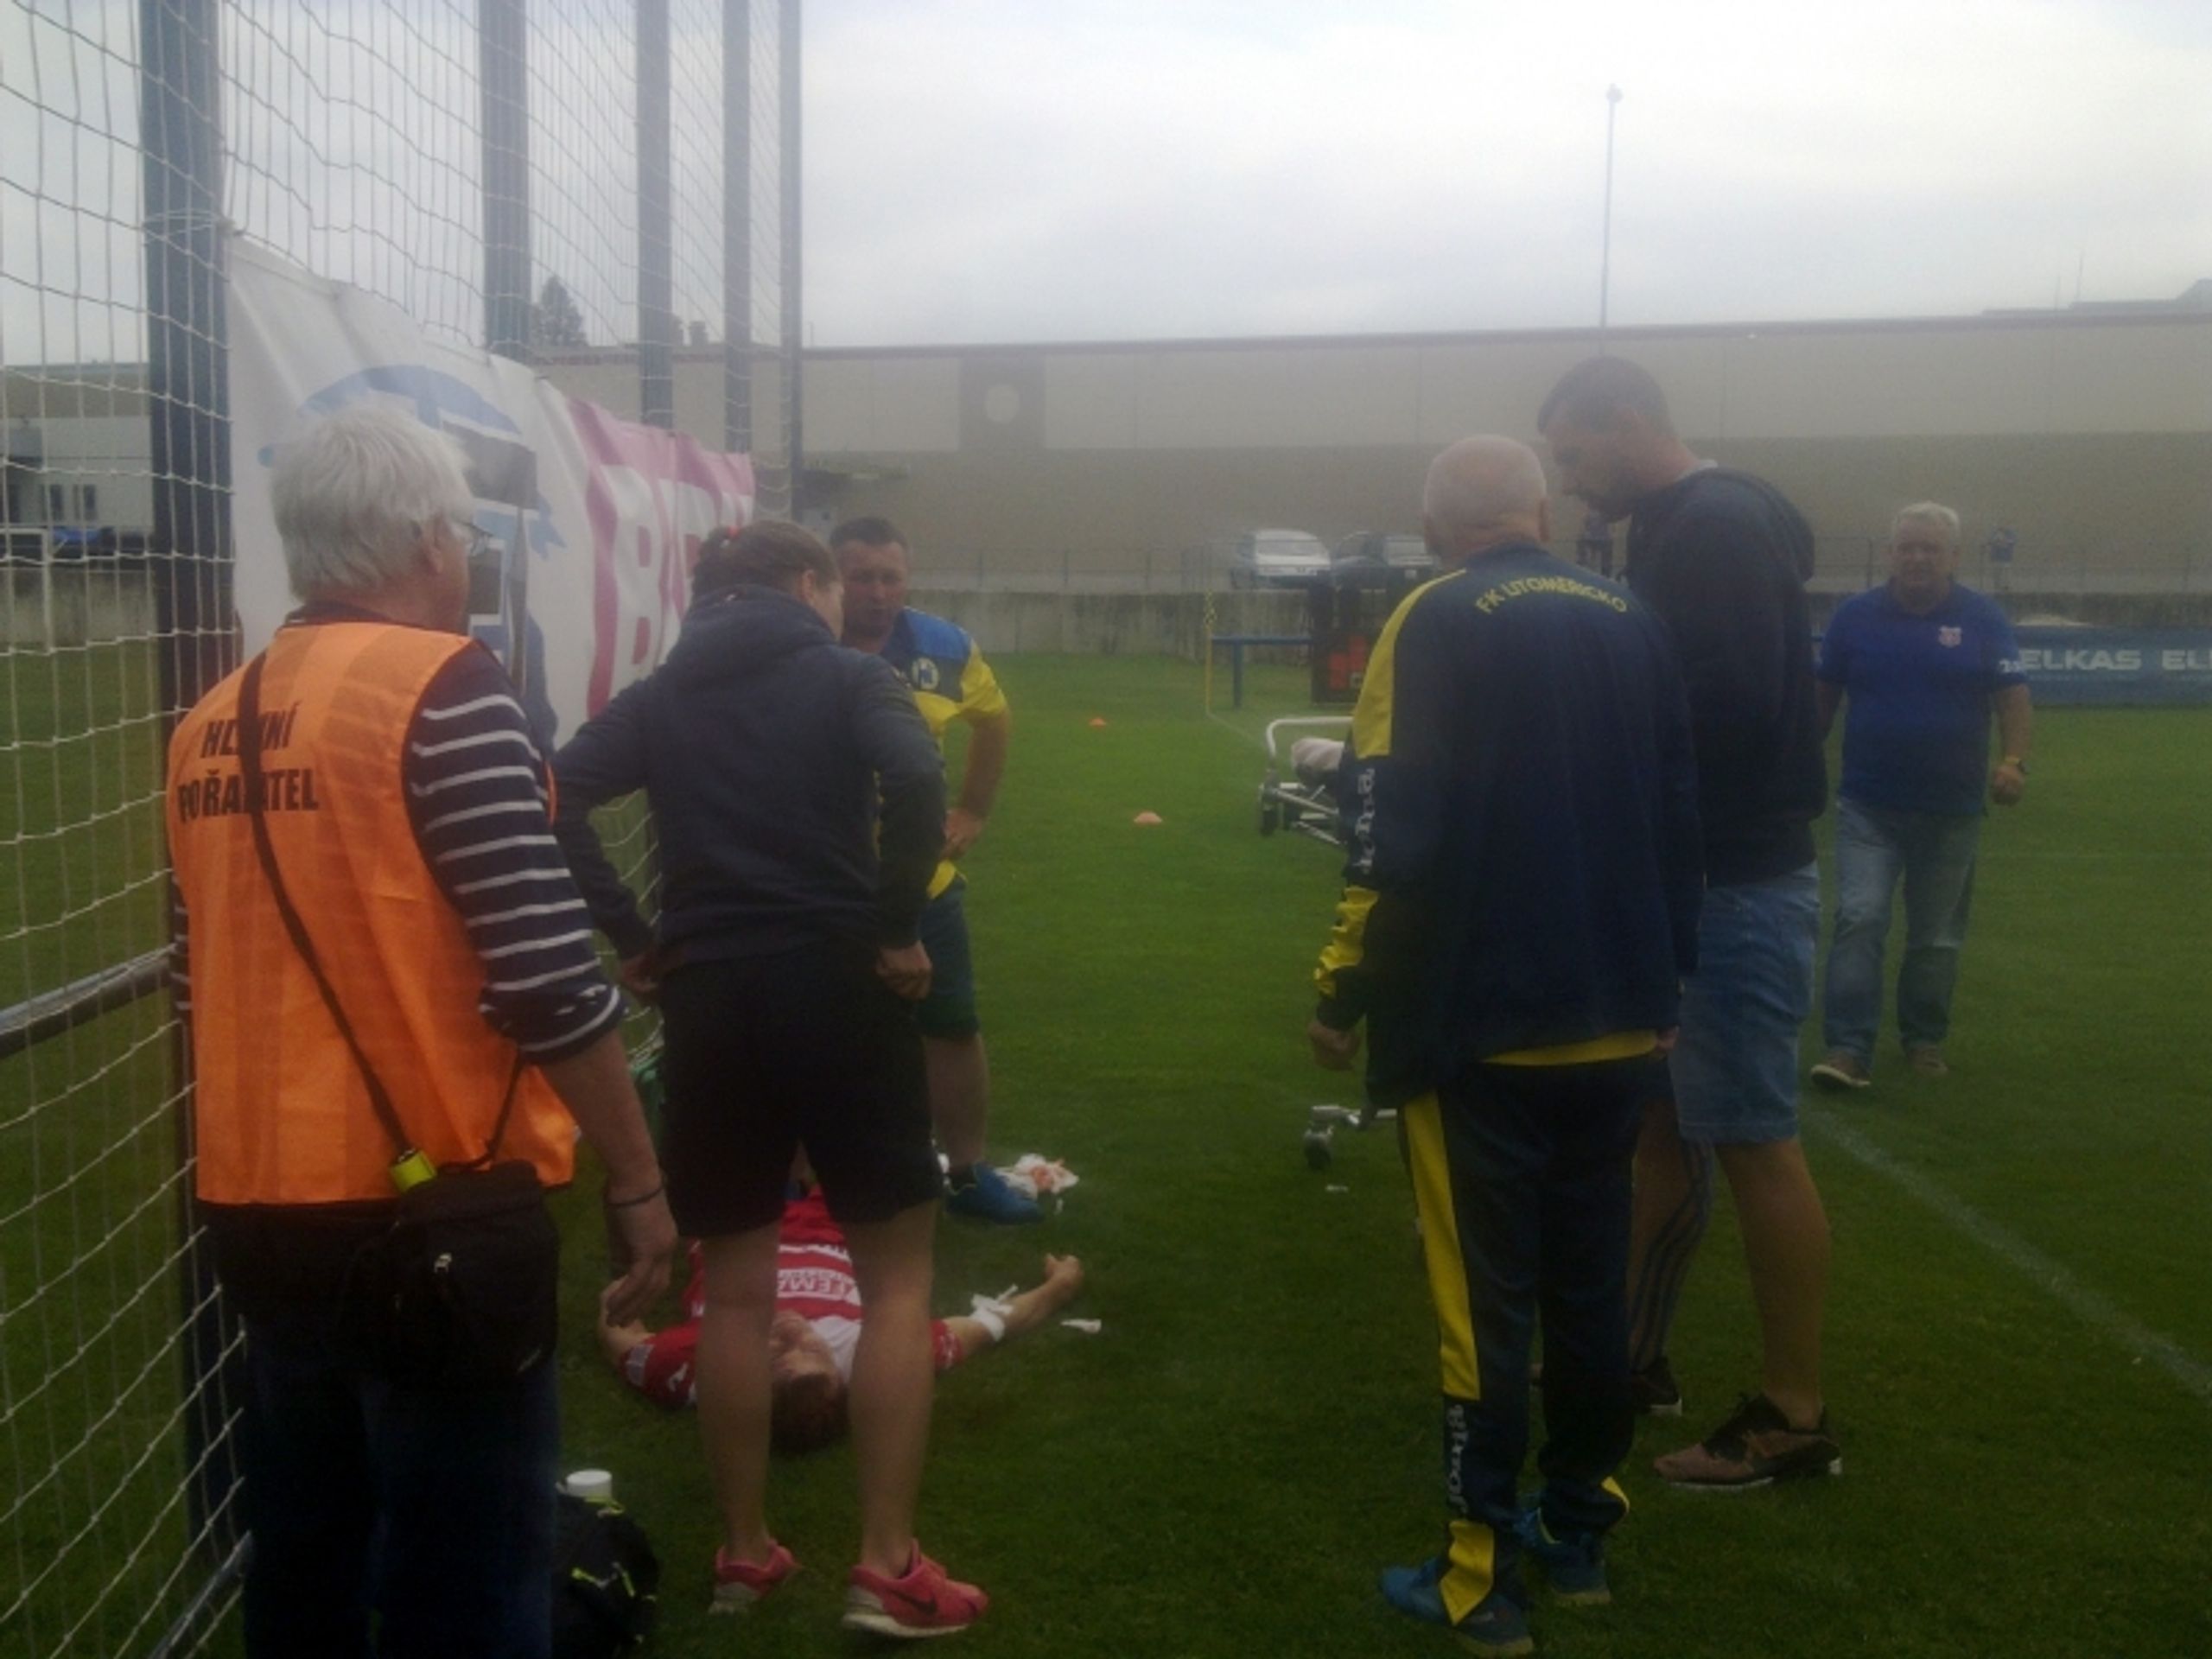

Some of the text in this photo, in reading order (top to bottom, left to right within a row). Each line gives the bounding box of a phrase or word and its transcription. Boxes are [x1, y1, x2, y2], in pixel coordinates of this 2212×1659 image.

[2019, 650, 2142, 671] ELKAS
[200, 701, 302, 758] HLNÍ
[177, 768, 319, 823] POŘATEL
